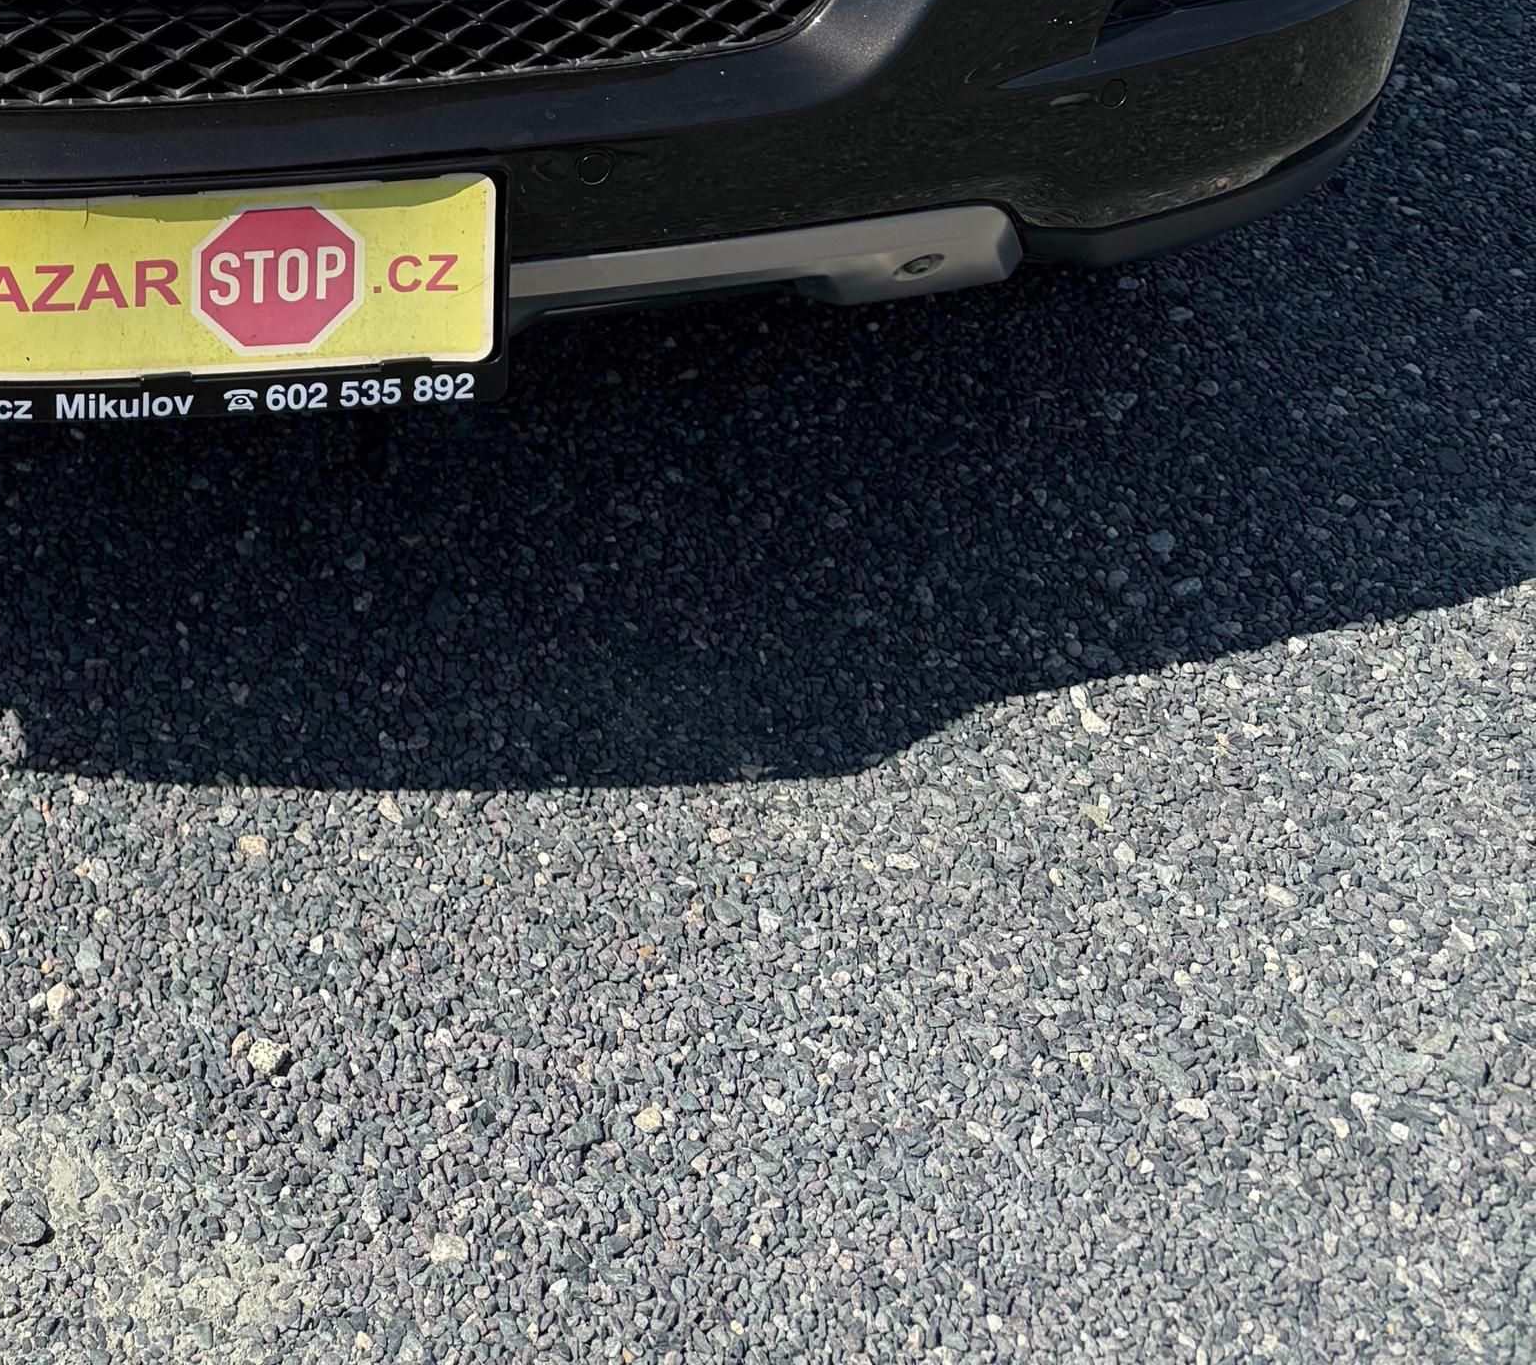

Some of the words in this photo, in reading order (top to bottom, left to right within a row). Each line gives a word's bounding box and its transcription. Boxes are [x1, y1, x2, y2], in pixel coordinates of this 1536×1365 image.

[208, 245, 347, 306] STOP
[55, 391, 194, 419] Mikulov
[265, 381, 329, 411] 602
[339, 377, 402, 408] 535
[413, 372, 476, 402] 892
